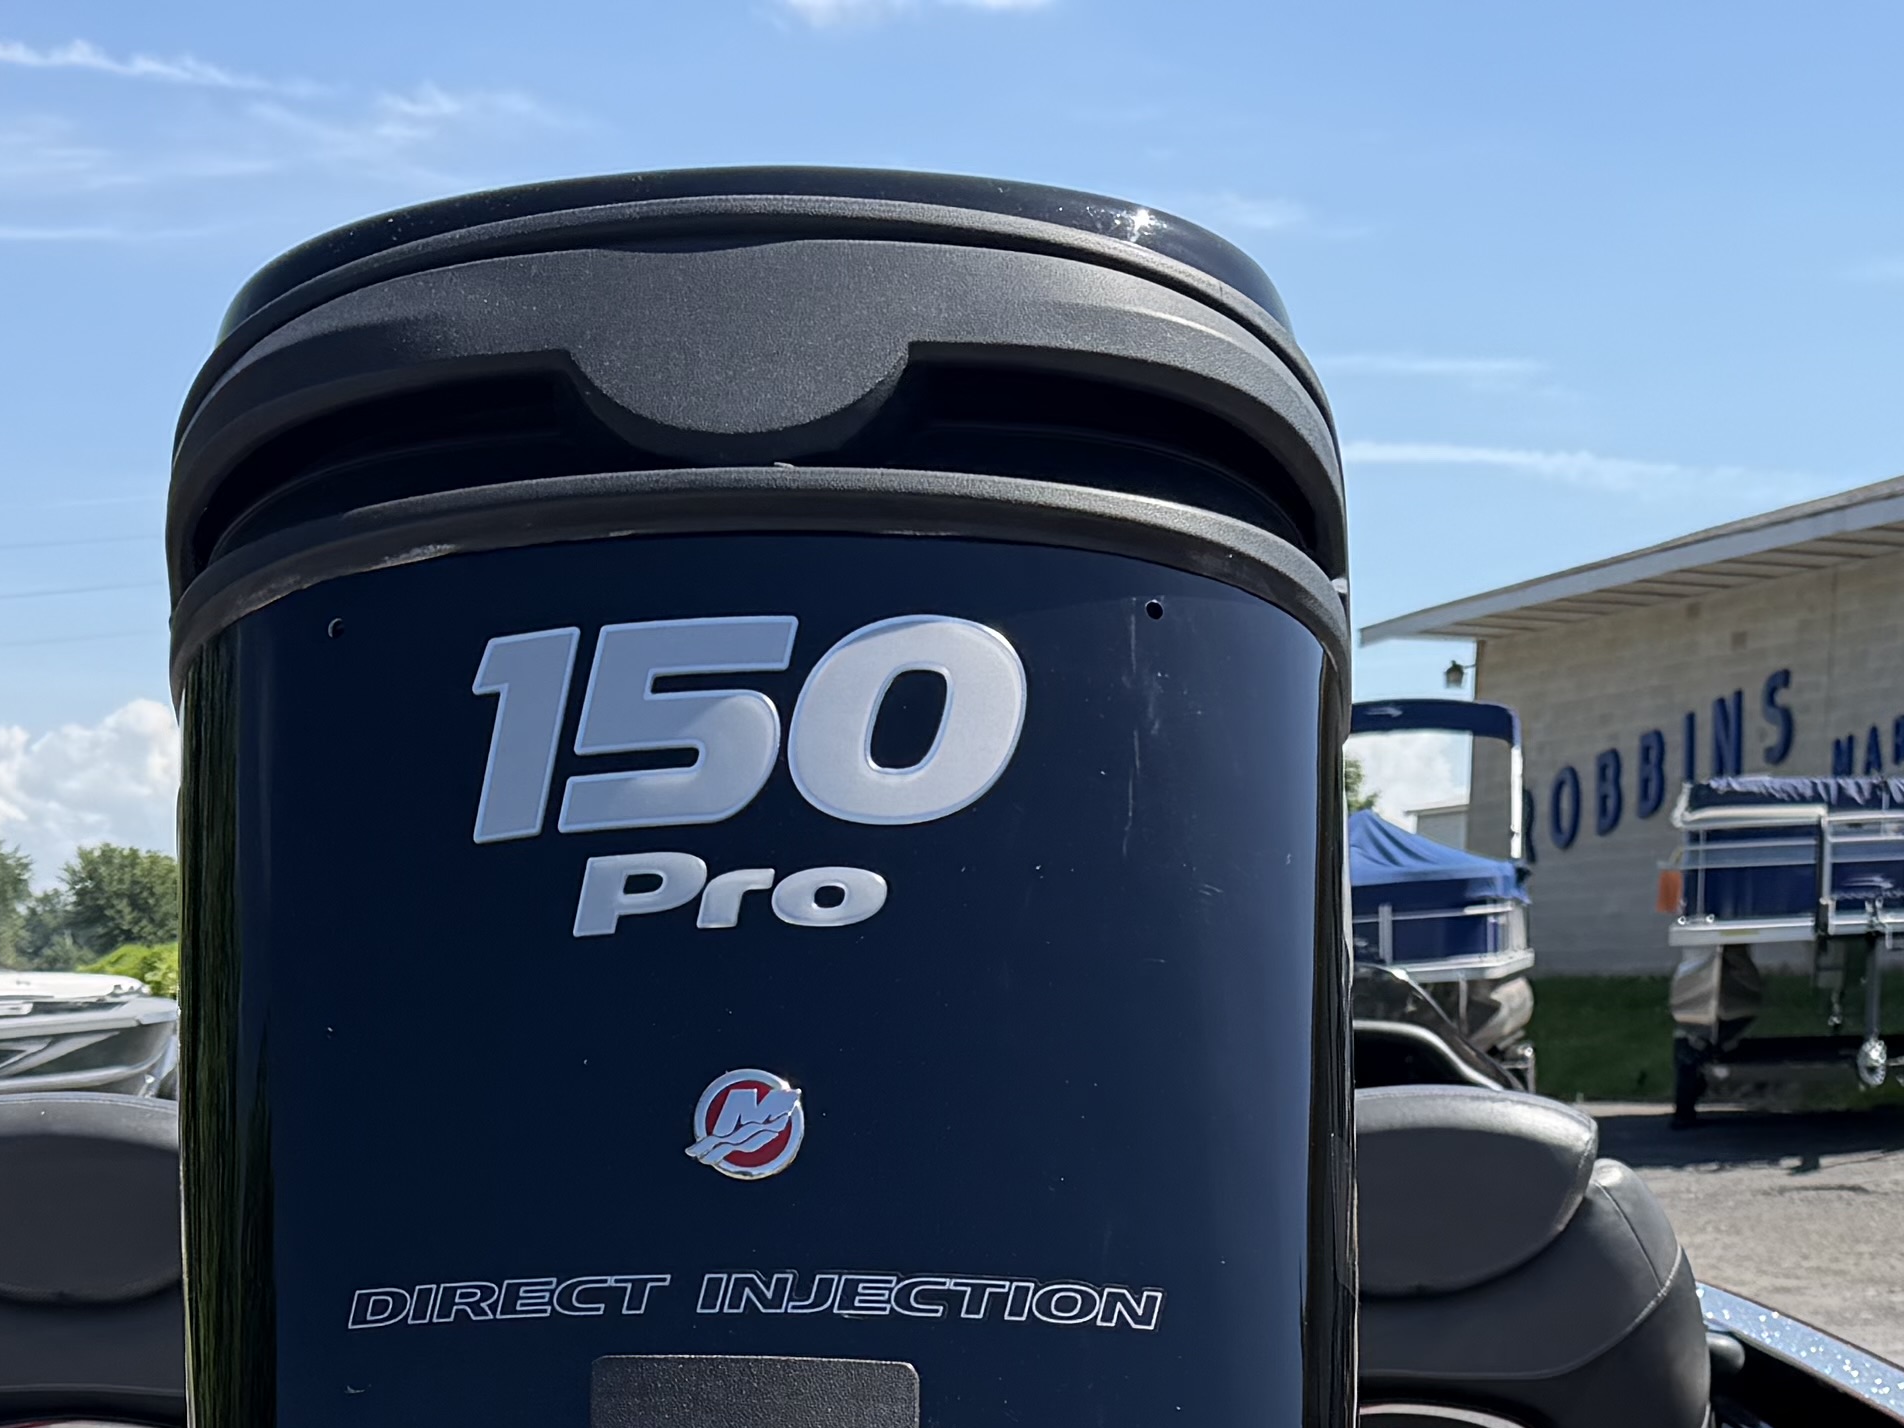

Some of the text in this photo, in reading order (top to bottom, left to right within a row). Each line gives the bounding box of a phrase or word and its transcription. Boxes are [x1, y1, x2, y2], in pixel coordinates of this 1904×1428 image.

[473, 614, 1027, 843] 150
[573, 851, 888, 938] Pro
[349, 1272, 1167, 1331] DIRECT INJECTION
